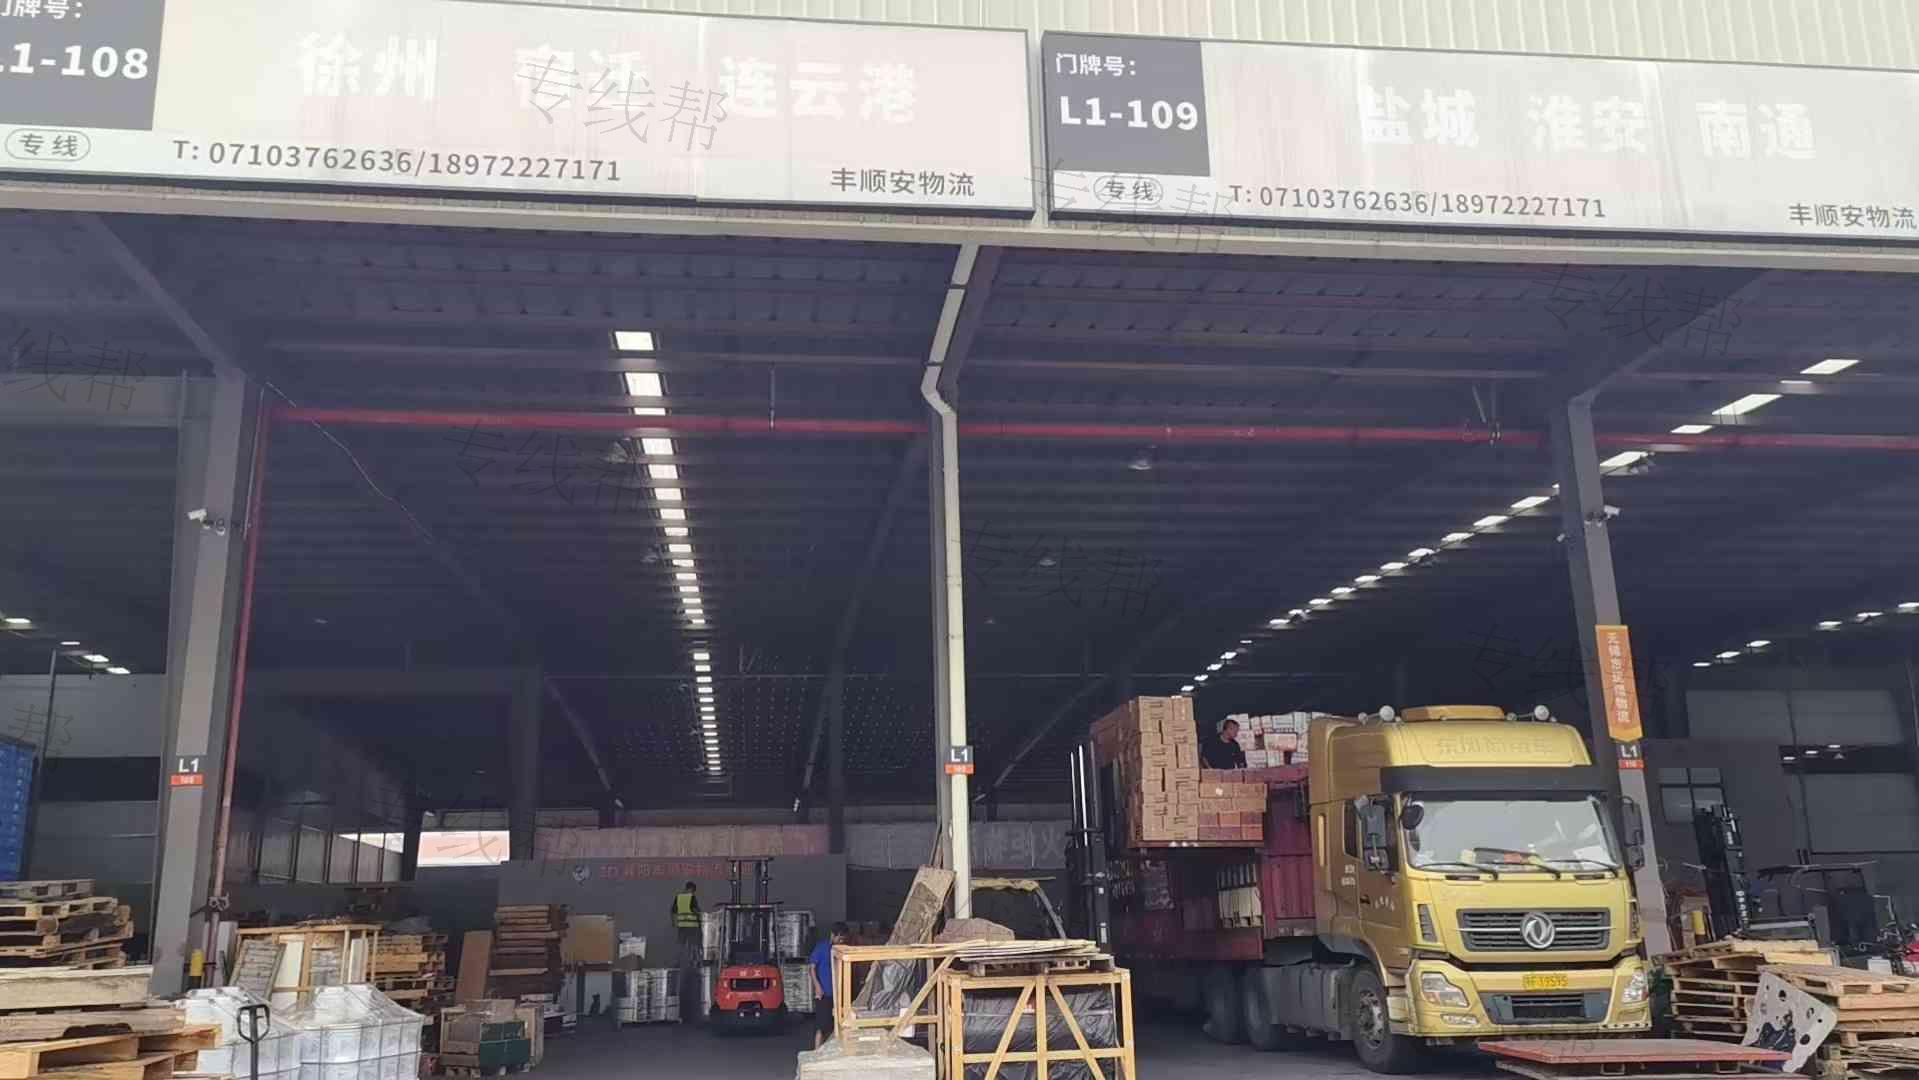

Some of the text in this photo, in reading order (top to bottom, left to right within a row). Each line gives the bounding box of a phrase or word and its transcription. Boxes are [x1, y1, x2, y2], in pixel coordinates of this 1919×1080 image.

[0, 42, 149, 80] 1-108
[297, 31, 438, 101] 徐州
[720, 56, 916, 123] 连云港
[1060, 95, 1199, 131] L1-109
[1361, 86, 1817, 159] 盐城 淮安 南通
[19, 133, 79, 157] 专线
[830, 167, 976, 197] 丰顺安物流
[1103, 179, 1155, 202] 专线
[1789, 202, 1918, 230] 丰顺安物流
[951, 748, 968, 762] L1
[1620, 744, 1637, 758] L1
[178, 758, 200, 773] L1
